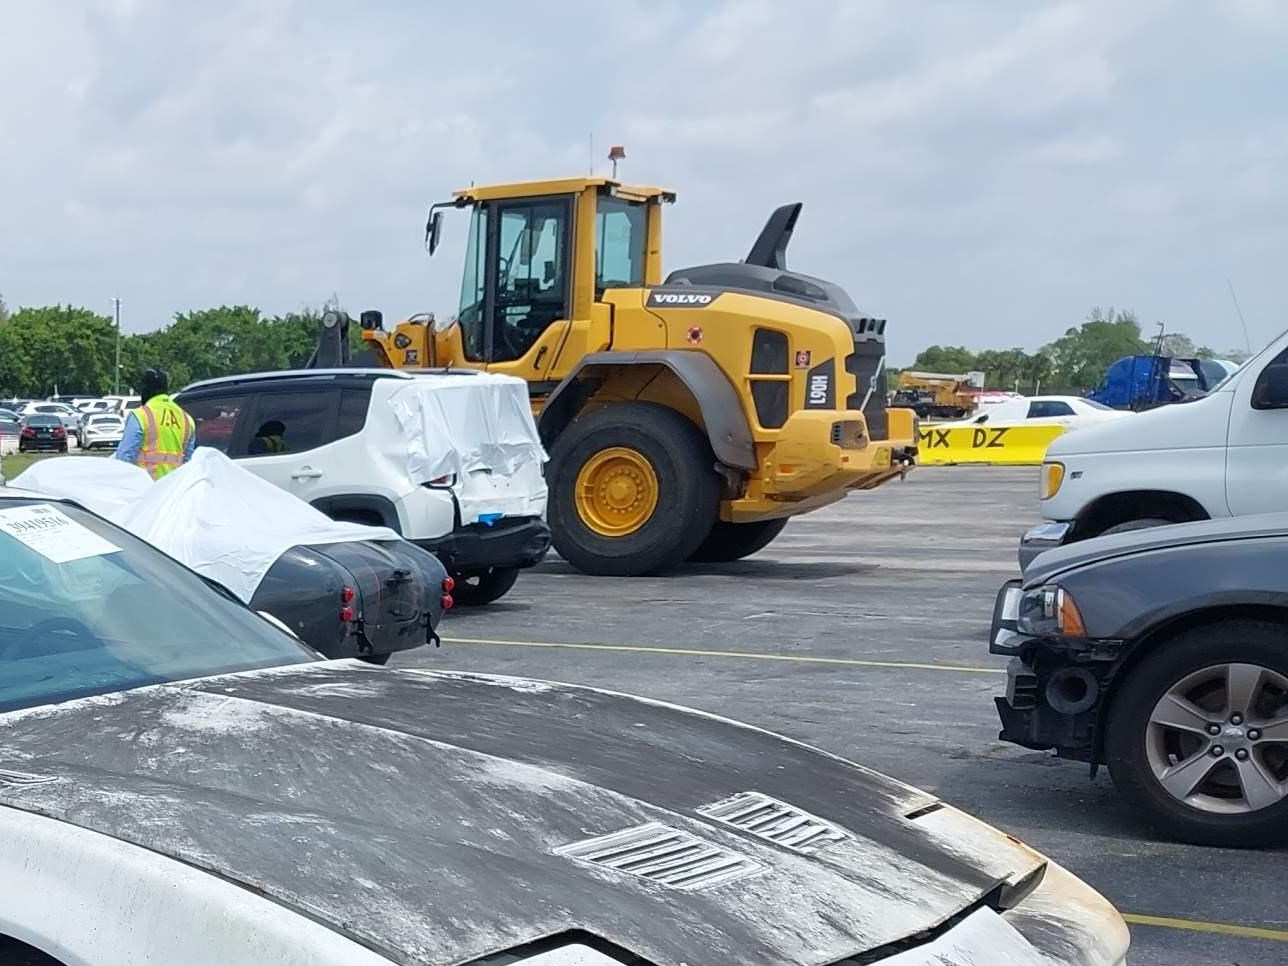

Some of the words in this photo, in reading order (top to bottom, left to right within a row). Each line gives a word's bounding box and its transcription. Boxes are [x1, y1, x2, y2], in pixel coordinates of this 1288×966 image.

[654, 294, 711, 304] VOLVO
[809, 375, 828, 404] L90H
[972, 428, 1011, 448] DZ
